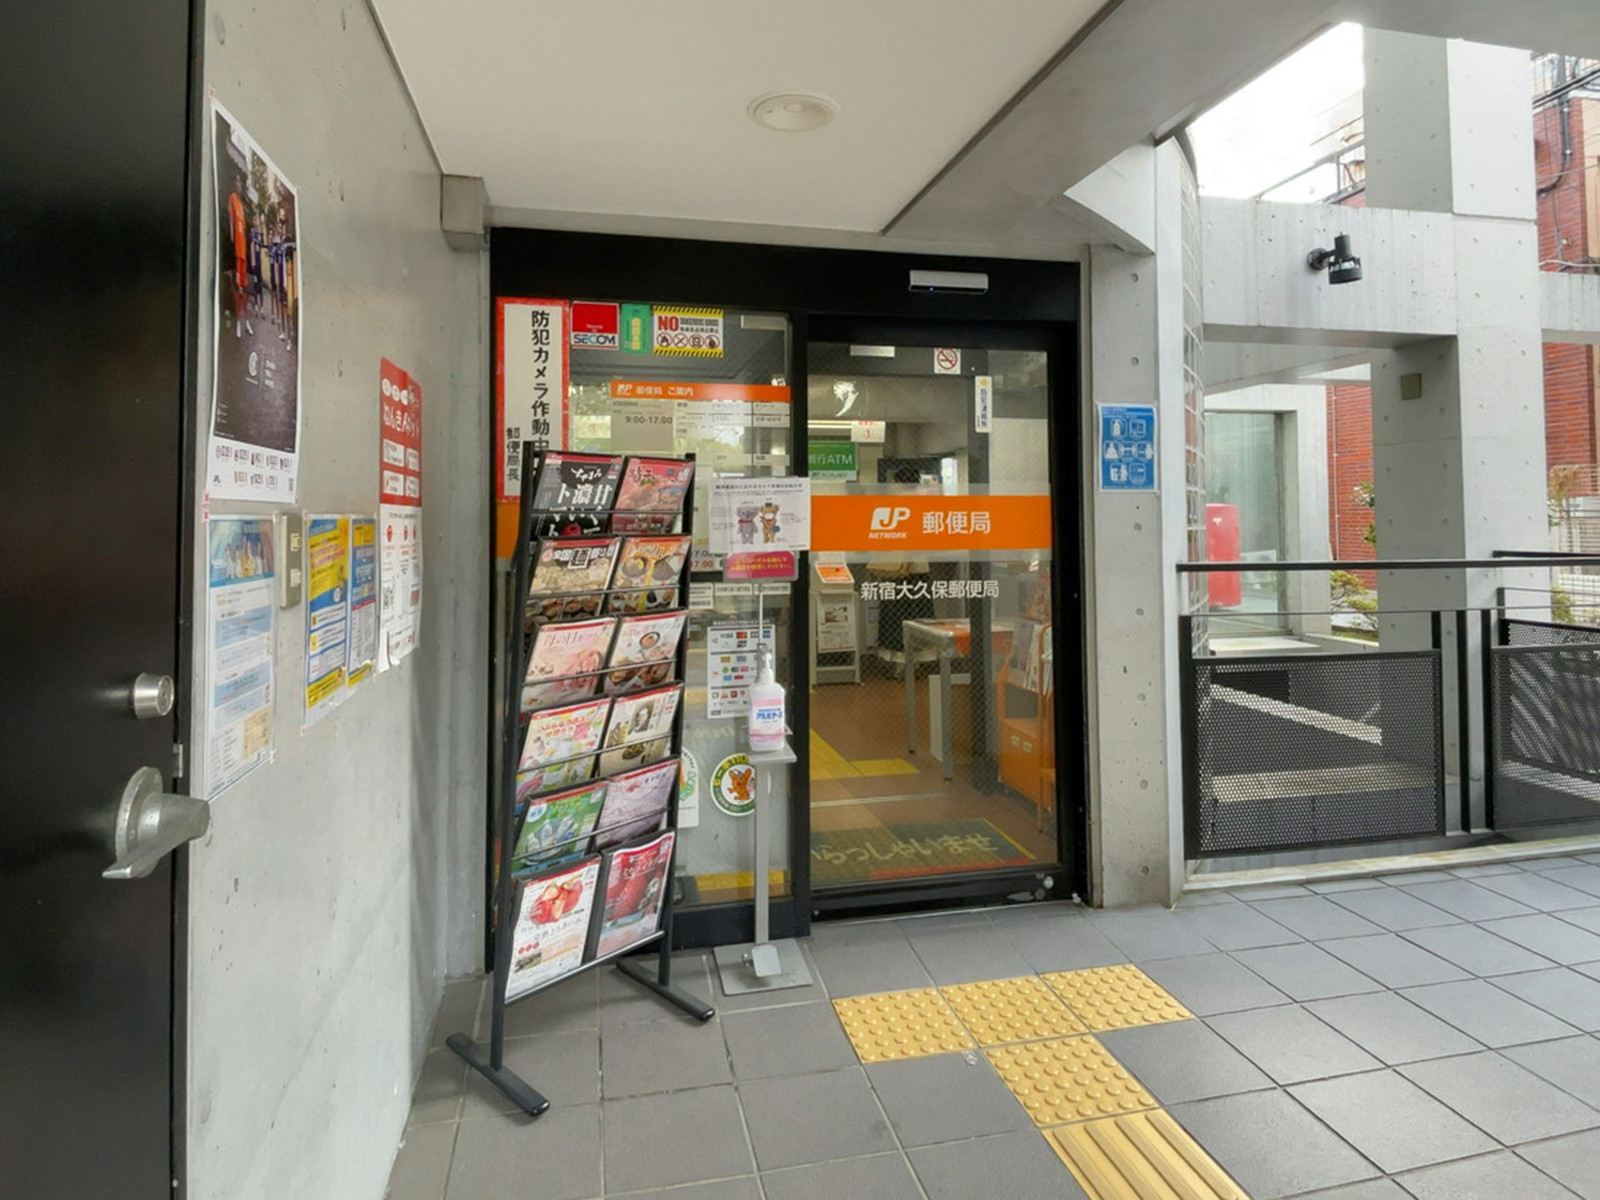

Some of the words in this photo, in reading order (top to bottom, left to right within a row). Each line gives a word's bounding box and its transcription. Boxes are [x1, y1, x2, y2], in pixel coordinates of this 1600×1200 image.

[657, 315, 679, 331] NO
[573, 334, 616, 345] SECOM
[625, 415, 673, 425] 9:00-17:00
[506, 427, 520, 482] 郵便局長
[871, 507, 911, 530] JP
[922, 511, 992, 535] 郵便局
[868, 532, 907, 540] NETWORK
[860, 580, 1000, 601] 新宿大久保郵便局
